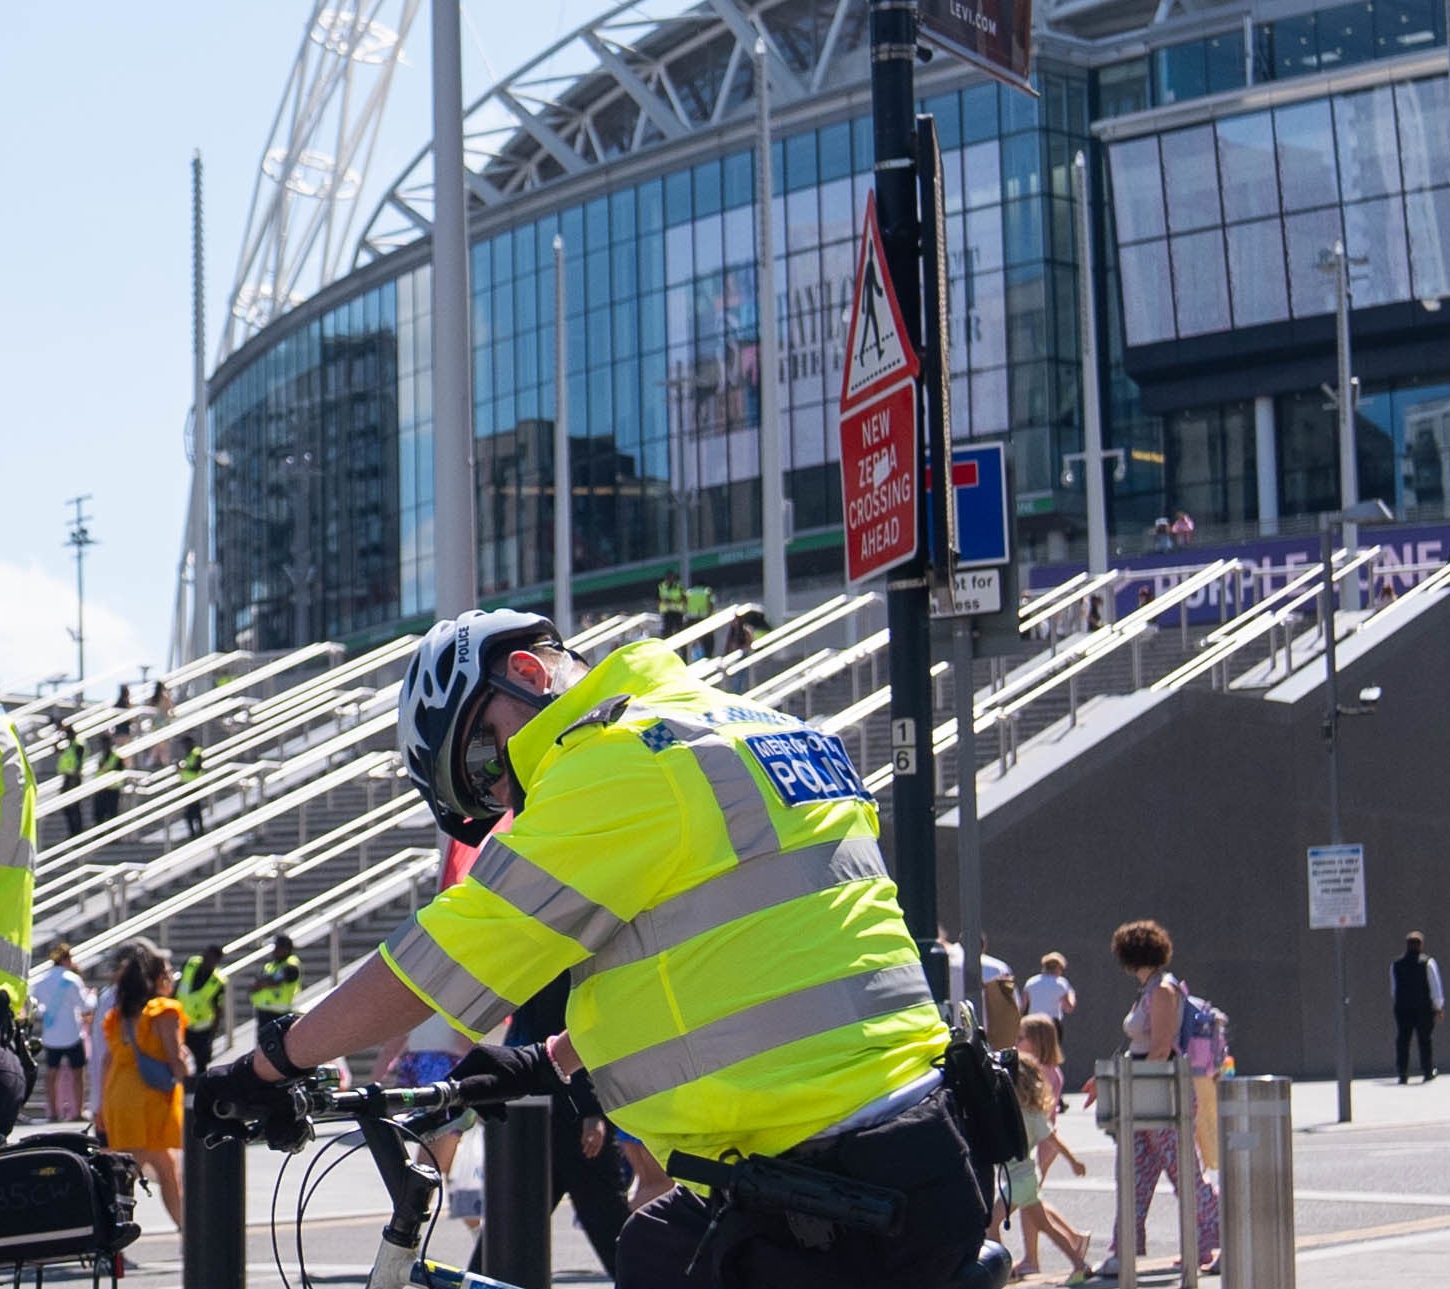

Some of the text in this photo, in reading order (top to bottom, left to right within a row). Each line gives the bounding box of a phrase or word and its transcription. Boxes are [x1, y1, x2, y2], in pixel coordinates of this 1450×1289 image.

[949, 0, 997, 37] LEVI.COM
[861, 407, 891, 449] NEW
[848, 472, 912, 530] CROSSING
[860, 515, 900, 561] AHEAD
[971, 574, 993, 590] for
[458, 624, 470, 665] POLICE
[897, 722, 908, 743] 1
[896, 750, 909, 770] 6
